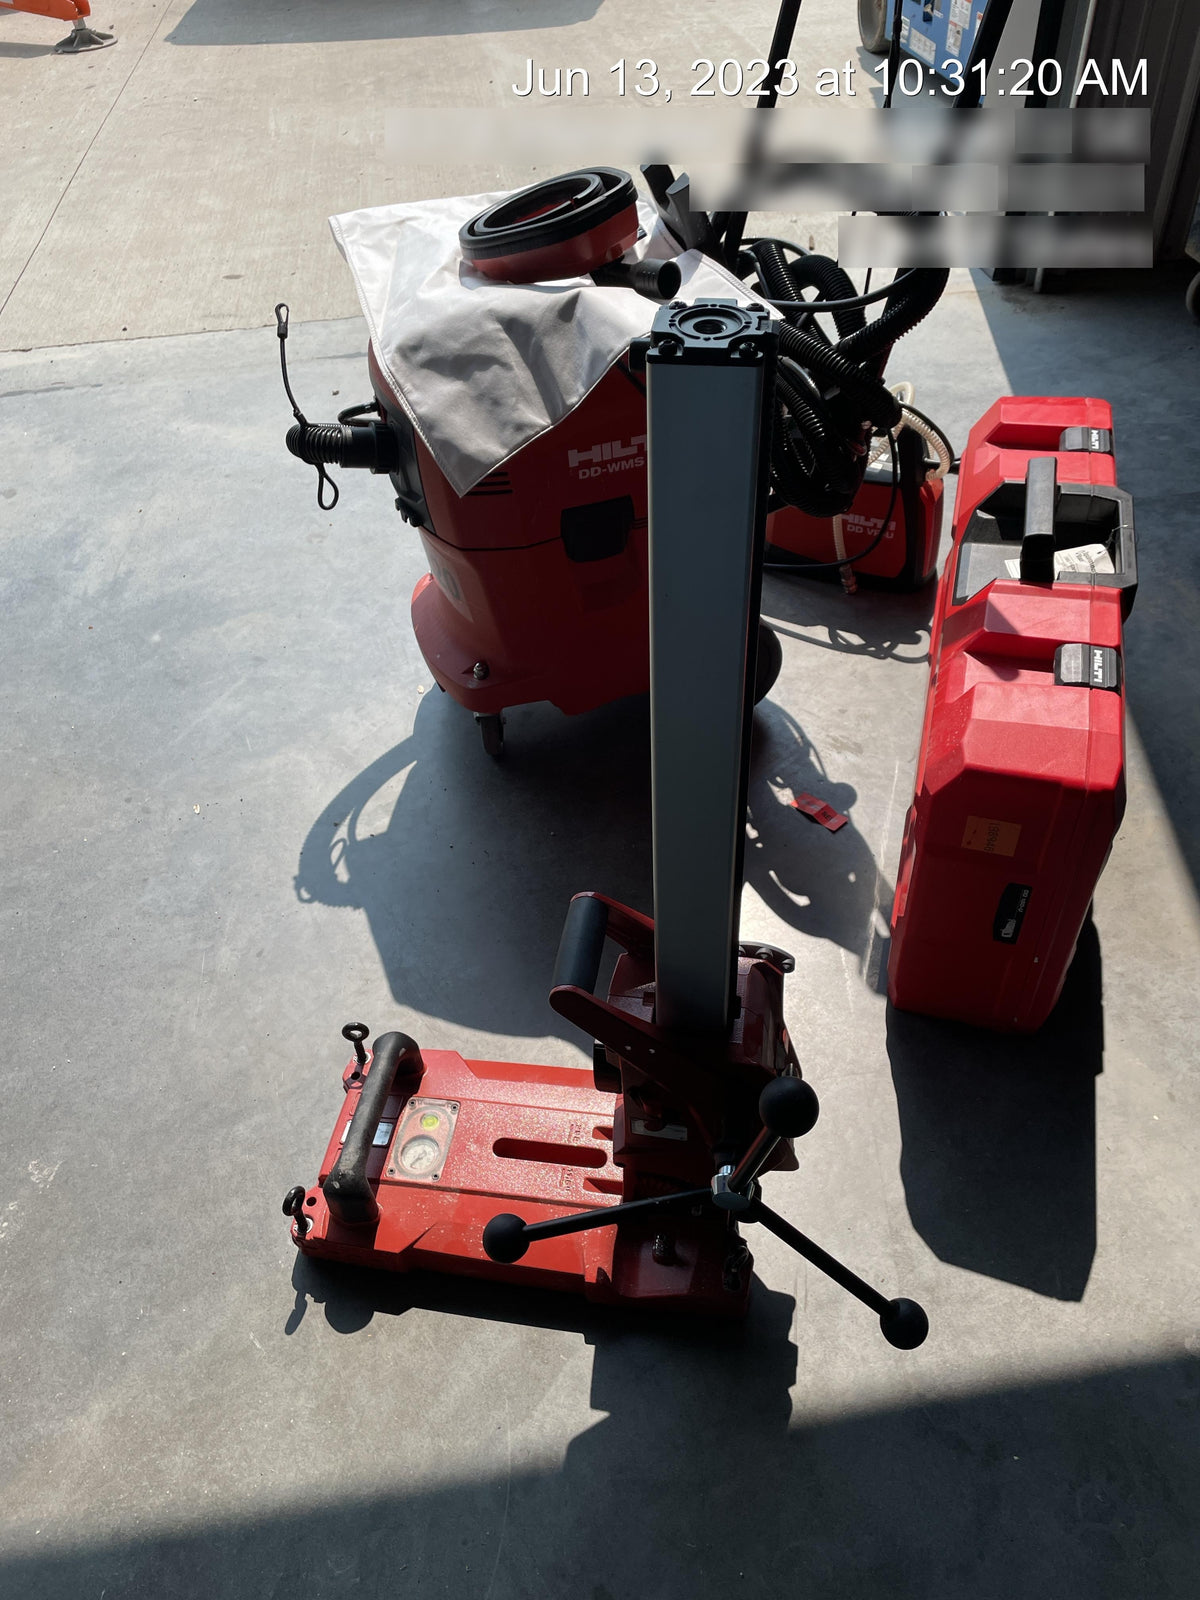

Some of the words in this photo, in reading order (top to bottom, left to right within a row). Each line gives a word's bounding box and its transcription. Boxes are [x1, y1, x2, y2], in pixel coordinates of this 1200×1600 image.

[567, 434, 647, 468] HILT
[1091, 429, 1099, 449] HILTI
[578, 456, 645, 480] DD-WMS
[847, 524, 864, 534] DD
[1093, 649, 1103, 683] HILTI
